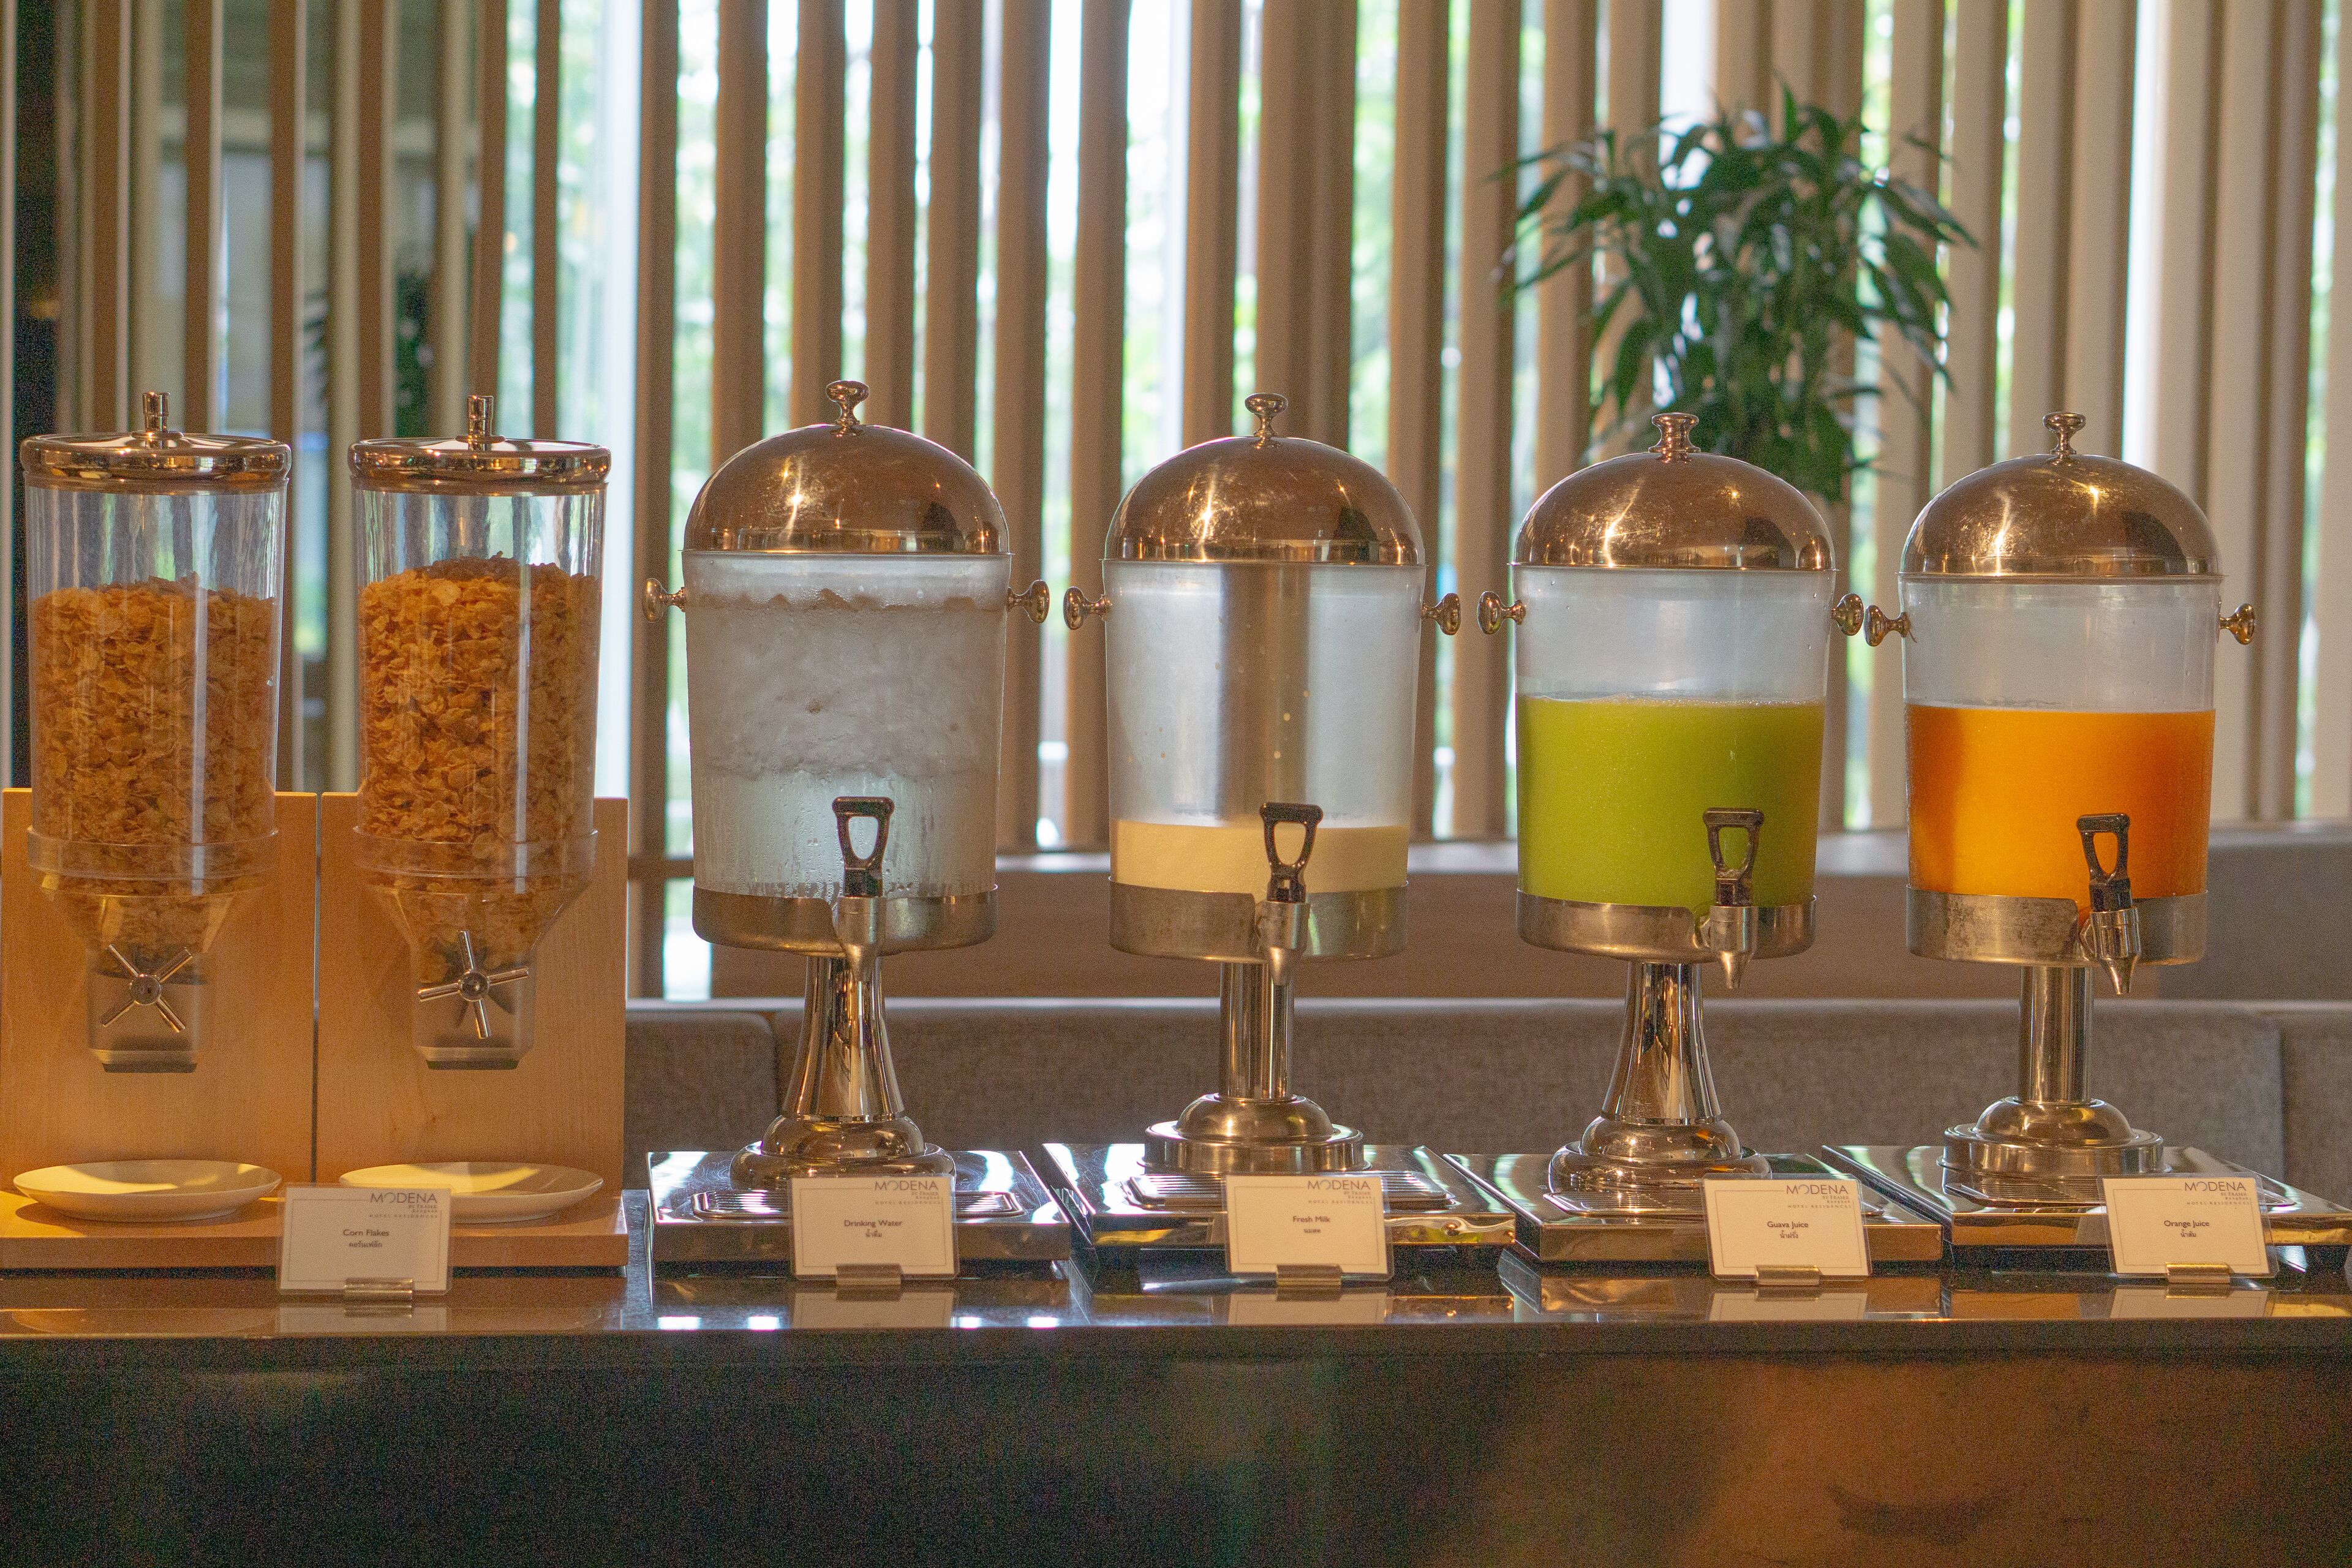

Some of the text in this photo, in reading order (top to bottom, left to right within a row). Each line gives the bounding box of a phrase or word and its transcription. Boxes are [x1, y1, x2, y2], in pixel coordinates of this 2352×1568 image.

[875, 1180, 938, 1191] MODENA
[1308, 1180, 1370, 1189] MODENA
[2185, 1182, 2246, 1191] MODENA
[1786, 1185, 1849, 1194] MODENA
[370, 1193, 437, 1203] MODENA
